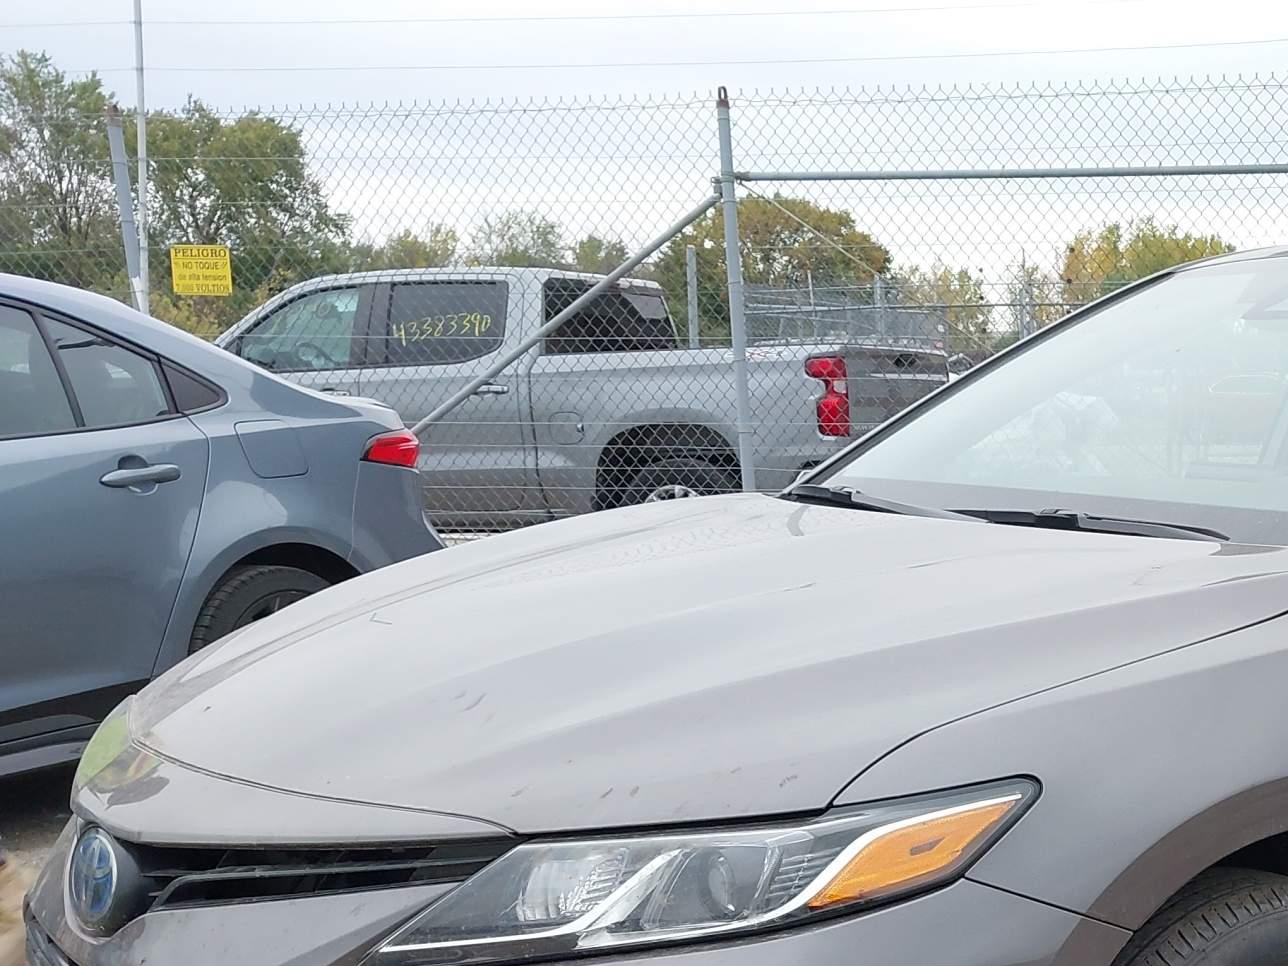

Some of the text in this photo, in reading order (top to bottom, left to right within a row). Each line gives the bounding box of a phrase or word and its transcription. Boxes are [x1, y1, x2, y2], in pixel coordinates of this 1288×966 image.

[174, 248, 227, 258] PELIGRO
[182, 261, 220, 270] NO TOQUE
[392, 312, 491, 347] 43383390
